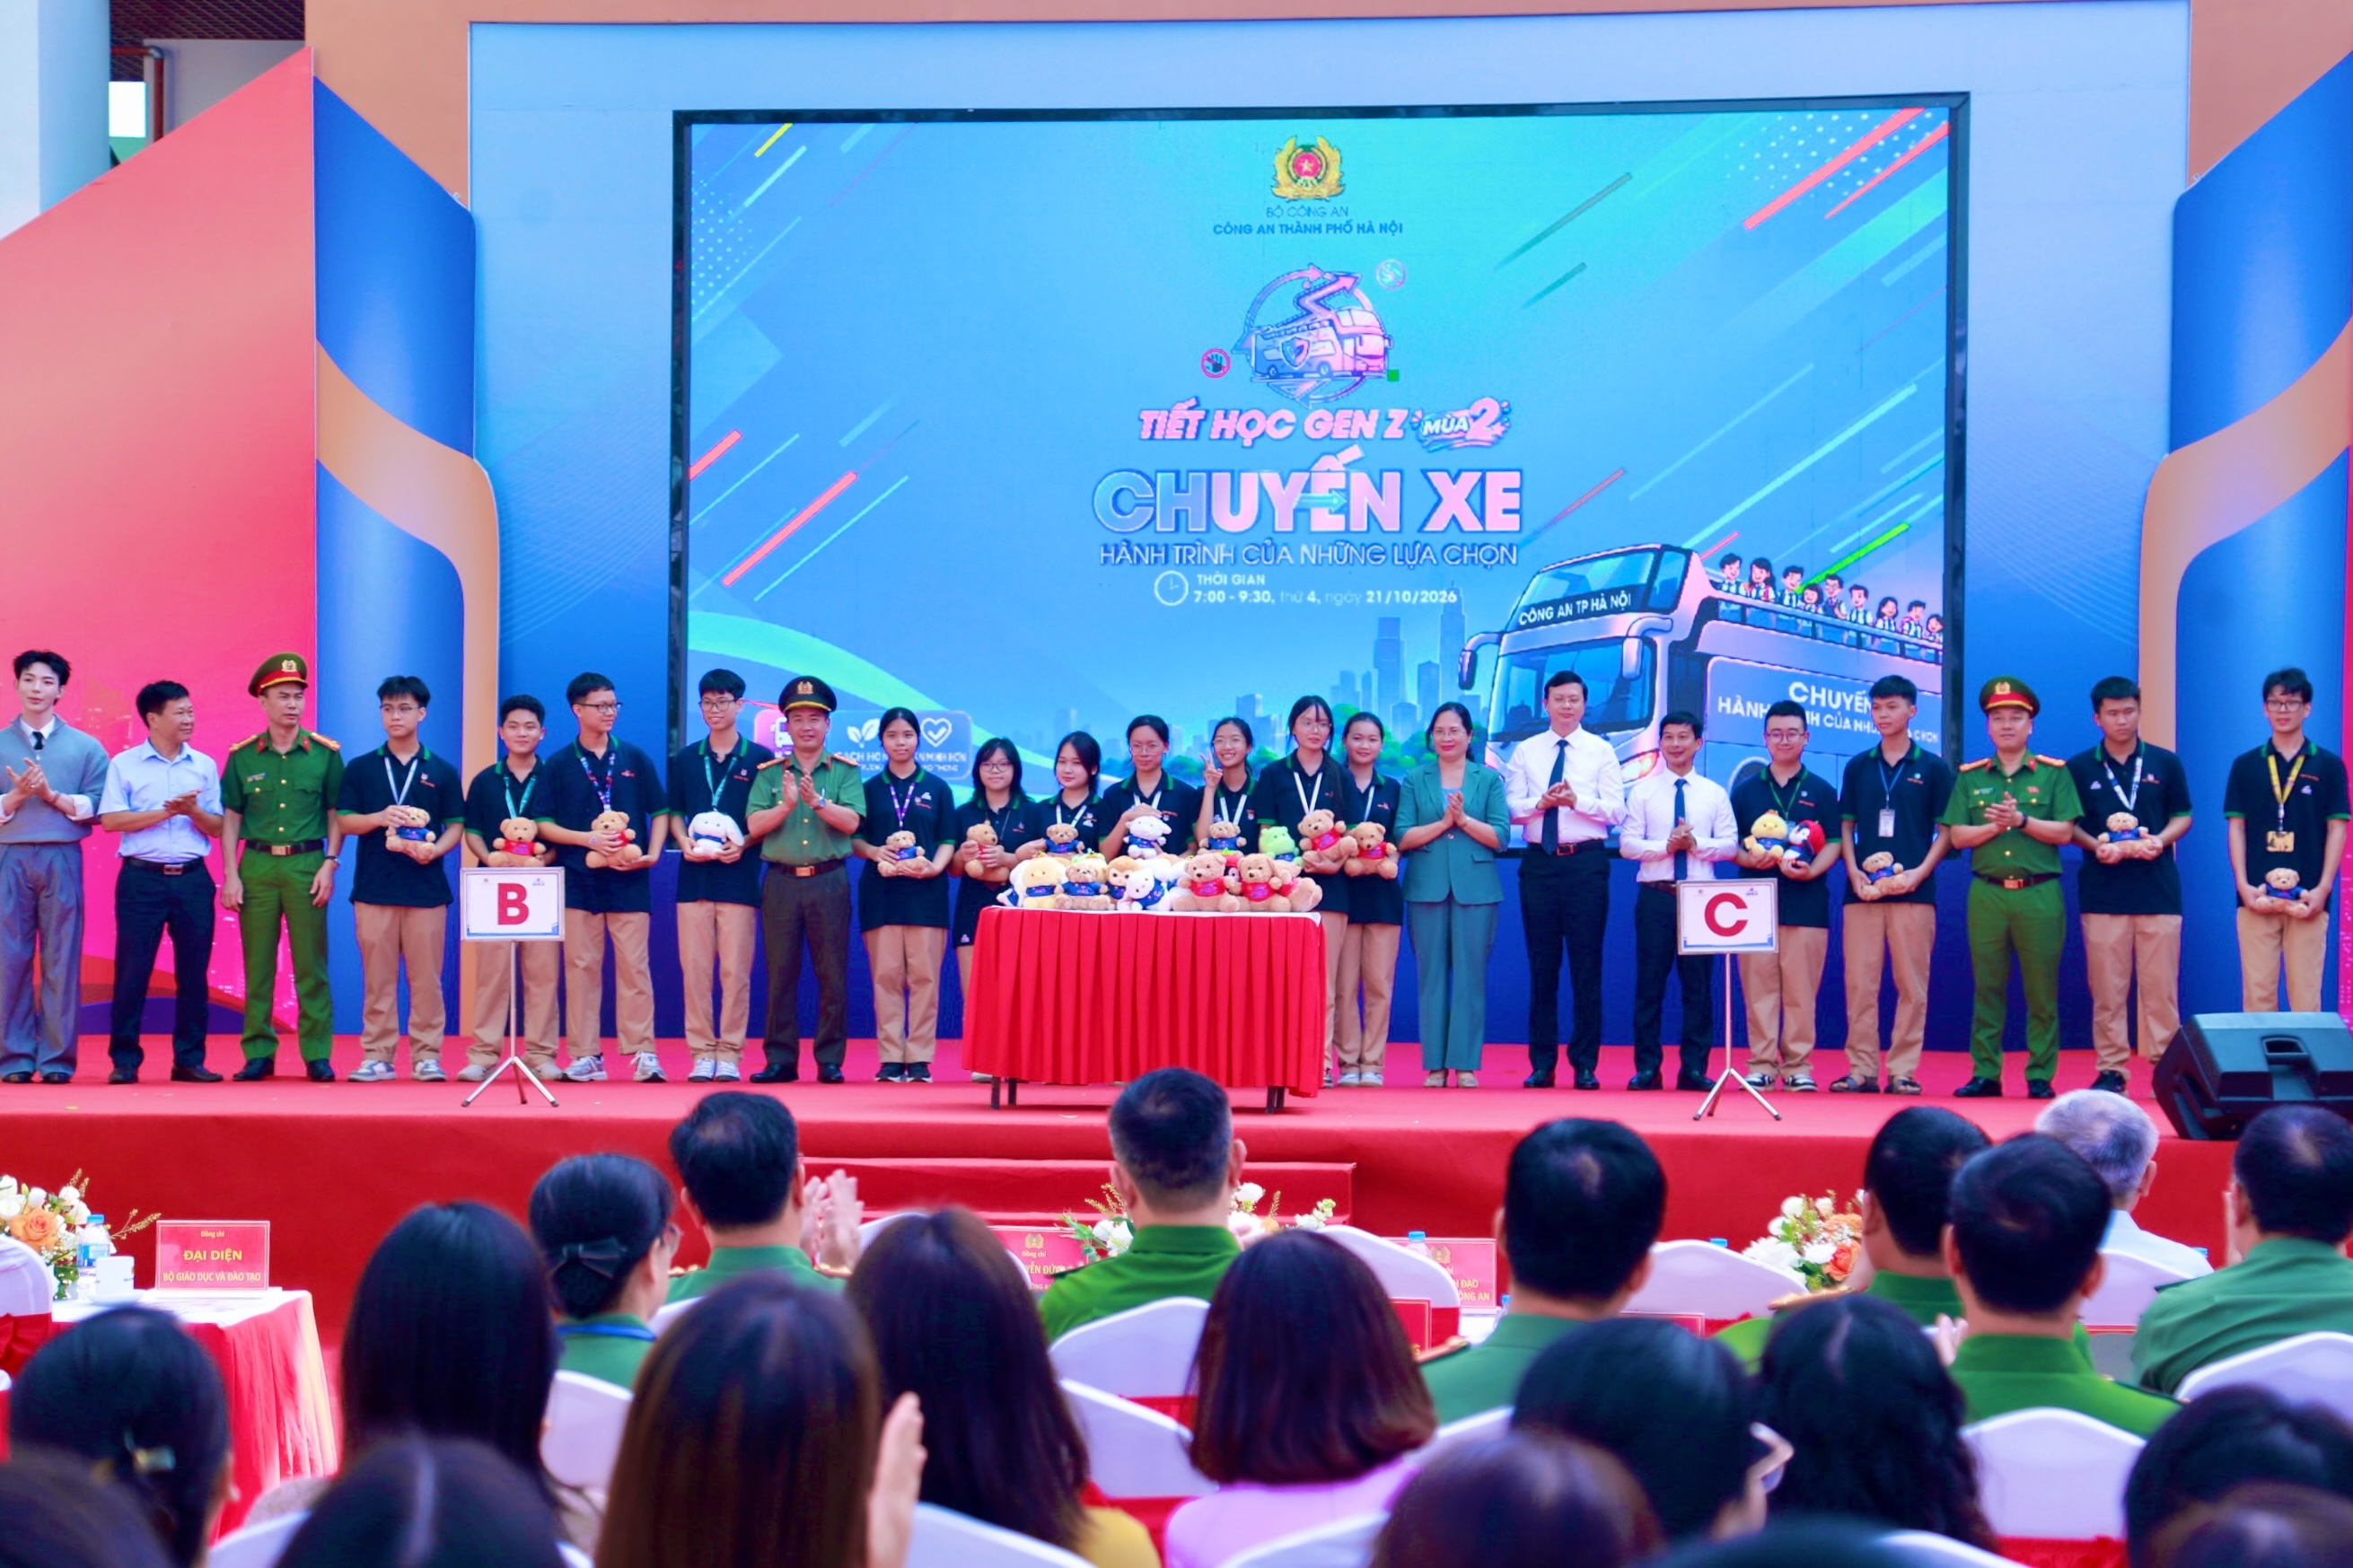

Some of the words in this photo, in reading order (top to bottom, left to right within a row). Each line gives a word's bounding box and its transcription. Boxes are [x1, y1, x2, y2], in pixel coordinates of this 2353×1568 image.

[1286, 205, 1327, 217] CÔNG
[1330, 206, 1348, 217] AN
[1213, 222, 1253, 235] CÔNG
[1257, 223, 1276, 234] AN
[1279, 221, 1321, 234] THÀNH
[1325, 219, 1353, 234] PHỐ
[1356, 220, 1375, 234] HÀ
[1379, 220, 1403, 236] NỘI
[1138, 397, 1207, 440] TIẾT
[1209, 408, 1297, 448] HỌC
[1304, 408, 1379, 440] GEN
[1382, 408, 1409, 440] Z
[1422, 414, 1470, 436] MÙA
[1465, 397, 1503, 442] 2
[1093, 443, 1401, 534] CHUYẾN
[1421, 470, 1522, 533] XE
[1100, 541, 1167, 565] HÀNH
[1172, 541, 1235, 565] TRÌNH
[1242, 539, 1295, 565] CỦA
[1300, 540, 1387, 565] NHỮNG
[1393, 543, 1438, 569] LỰA
[1444, 544, 1517, 569] CHỌN
[1197, 571, 1227, 585] THỜI
[1231, 574, 1265, 585] GIAN
[1193, 590, 1226, 603] 7:00
[1238, 590, 1275, 604] 9:30,
[1306, 590, 1321, 604] 4,
[1365, 590, 1458, 604] 21/10/2026
[1518, 606, 1554, 626] CÔNG
[1557, 602, 1573, 618] AN
[1576, 600, 1589, 614] TP
[1591, 592, 1608, 612] HÀ
[1611, 590, 1631, 611] NỘI
[1823, 711, 1852, 730] CỦA
[497, 883, 530, 925] B
[1704, 892, 1749, 937] C
[201, 1230, 215, 1239] Đồng
[183, 1249, 206, 1263] ĐẠI
[210, 1248, 243, 1263] DIỆN
[163, 1270, 175, 1283] BỘ
[176, 1270, 196, 1282] GIÁO
[198, 1272, 214, 1283] DỤC
[215, 1270, 226, 1282] VÀ
[227, 1270, 244, 1282] ĐÀO
[246, 1272, 261, 1283] TẠO
[1461, 1278, 1479, 1291] ĐẠO
[1459, 1290, 1477, 1301] ÔNG
[1478, 1292, 1490, 1301] AN
